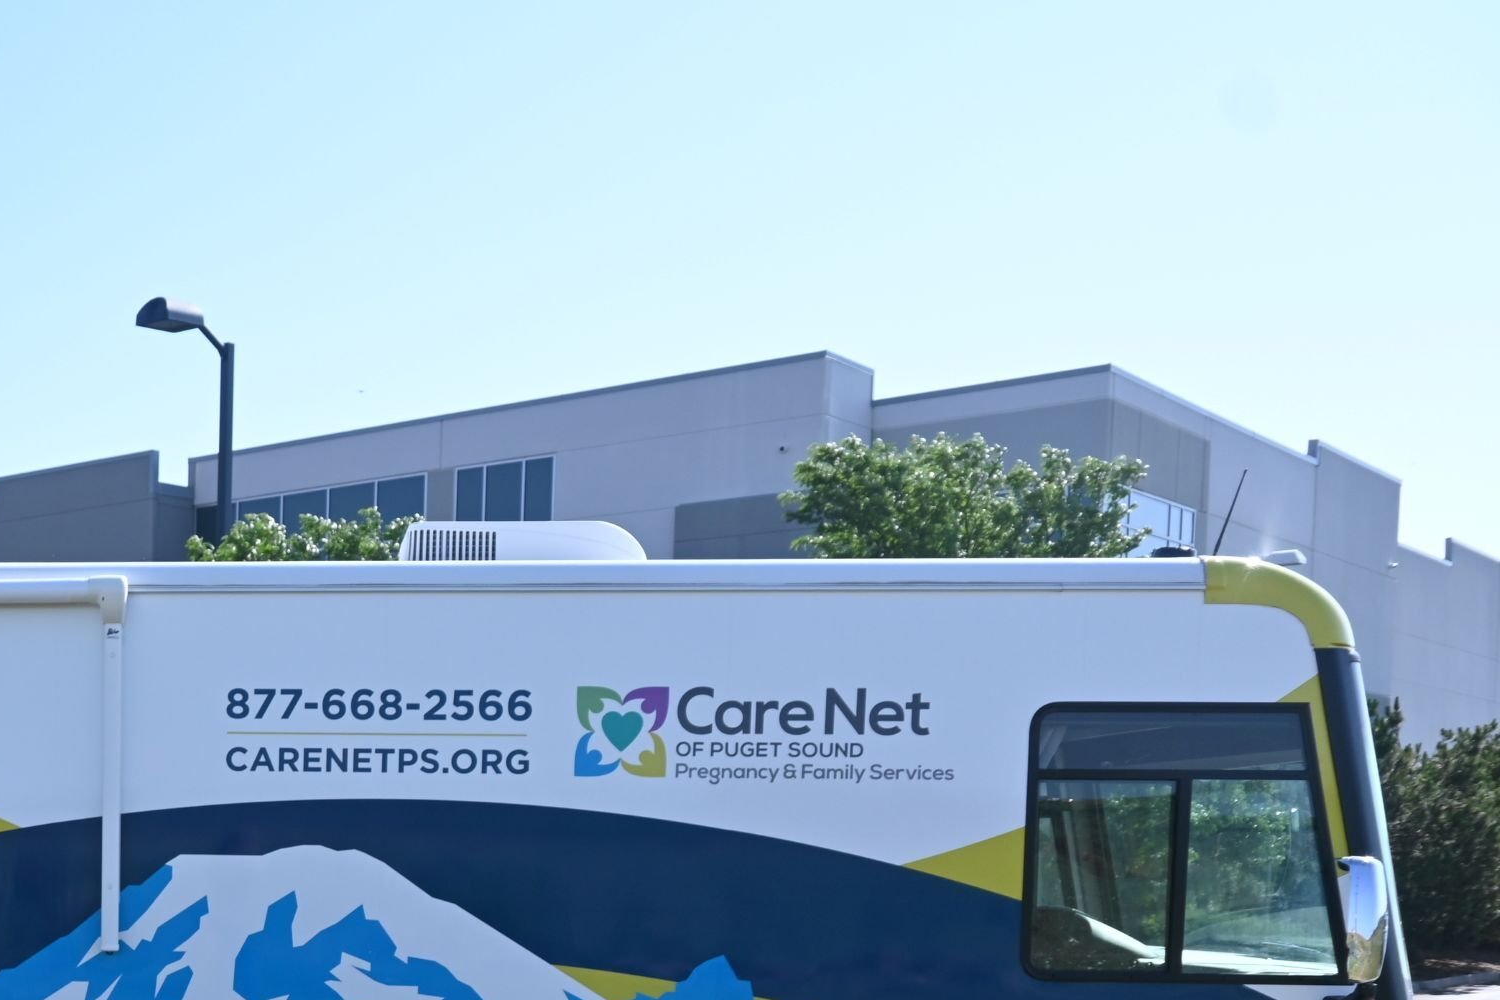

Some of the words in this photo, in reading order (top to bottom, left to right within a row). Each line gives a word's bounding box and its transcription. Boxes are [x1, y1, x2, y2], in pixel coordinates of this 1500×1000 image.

[226, 687, 533, 722] 877-668-2566
[676, 686, 815, 736] Care
[823, 687, 931, 737] Net
[225, 746, 530, 776] CARENETPS.ORG
[675, 740, 705, 758] OF
[709, 741, 783, 758] PUGET
[787, 741, 864, 759] SOUND
[675, 762, 780, 786] Pregnancy
[782, 763, 798, 780] &
[800, 763, 865, 785] Family
[869, 763, 955, 782] Services
